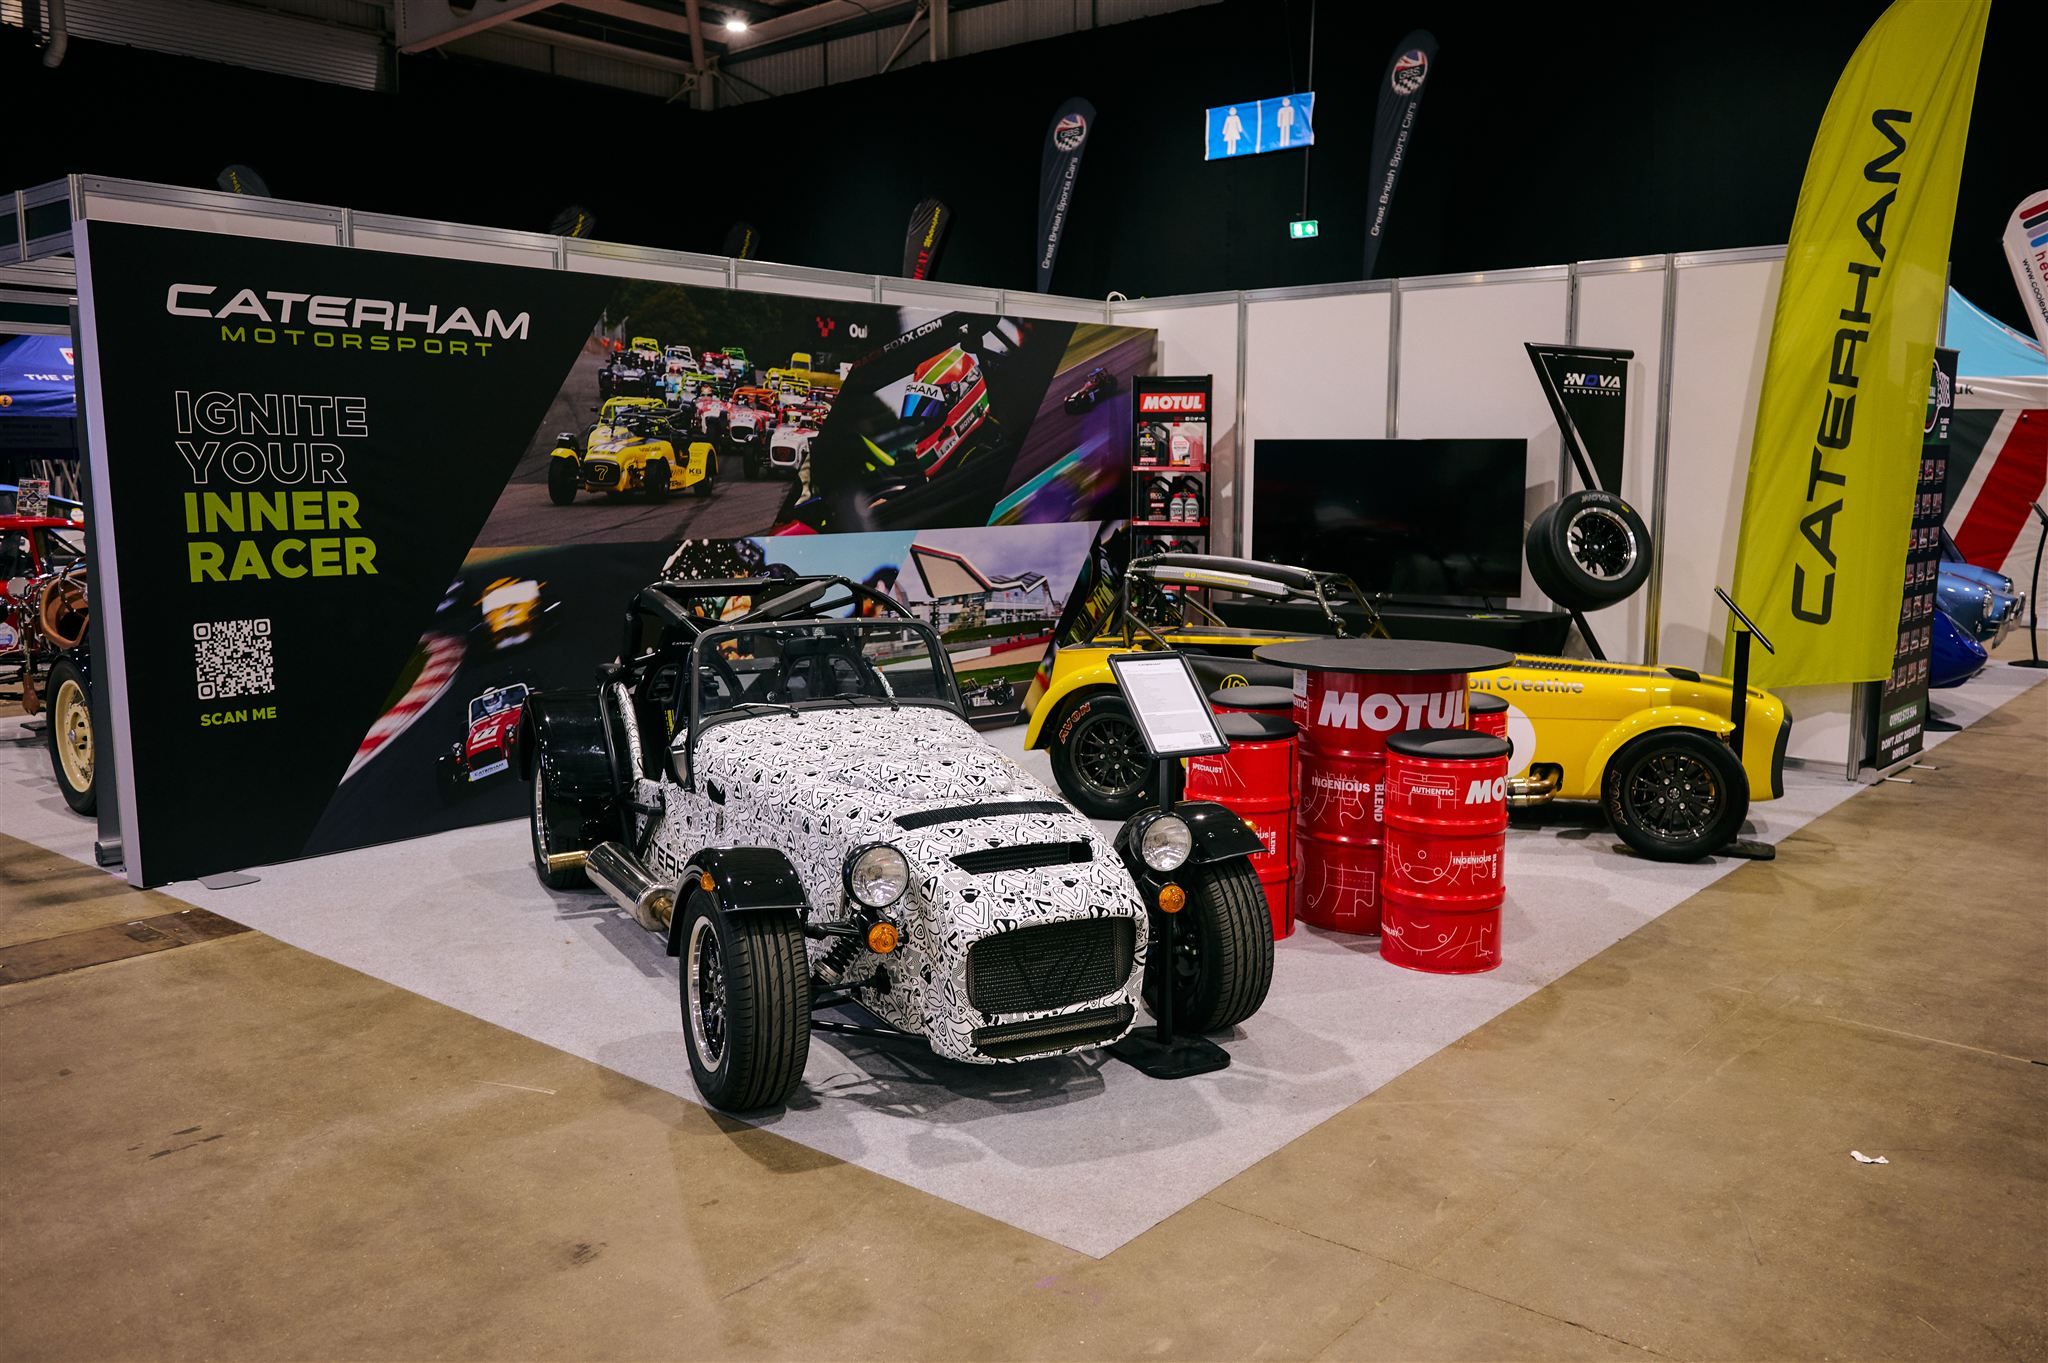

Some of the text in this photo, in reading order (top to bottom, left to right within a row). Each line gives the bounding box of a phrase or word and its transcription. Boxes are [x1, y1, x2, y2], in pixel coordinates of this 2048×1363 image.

[1371, 101, 1417, 237] Great British Sports Cars
[1042, 157, 1079, 269] Great British Sports Cars
[166, 283, 530, 340] CATERHAM
[221, 325, 493, 357] MOTORSPORT
[24, 373, 60, 381] THE
[1564, 372, 1621, 388] NOVA
[1791, 109, 1913, 626] CATERHAM
[1143, 395, 1202, 409] MOTUL
[1563, 388, 1620, 397] MOTORSPORT
[175, 390, 368, 437] IGNITE
[175, 441, 347, 484] YOUR
[594, 465, 609, 482] 7
[184, 491, 362, 533] INNER
[188, 537, 379, 583] RACER
[1496, 676, 1585, 693] Creative
[200, 706, 277, 727] SCAN ME
[1058, 702, 1091, 744] AVON
[1318, 690, 1466, 732] MOTUL
[1312, 776, 1370, 793] INGENIOUS
[1411, 786, 1455, 796] AUTHENTIC
[1465, 777, 1508, 804] MO
[1374, 784, 1385, 822] BLEND
[1453, 855, 1492, 864] INGENIOUS
